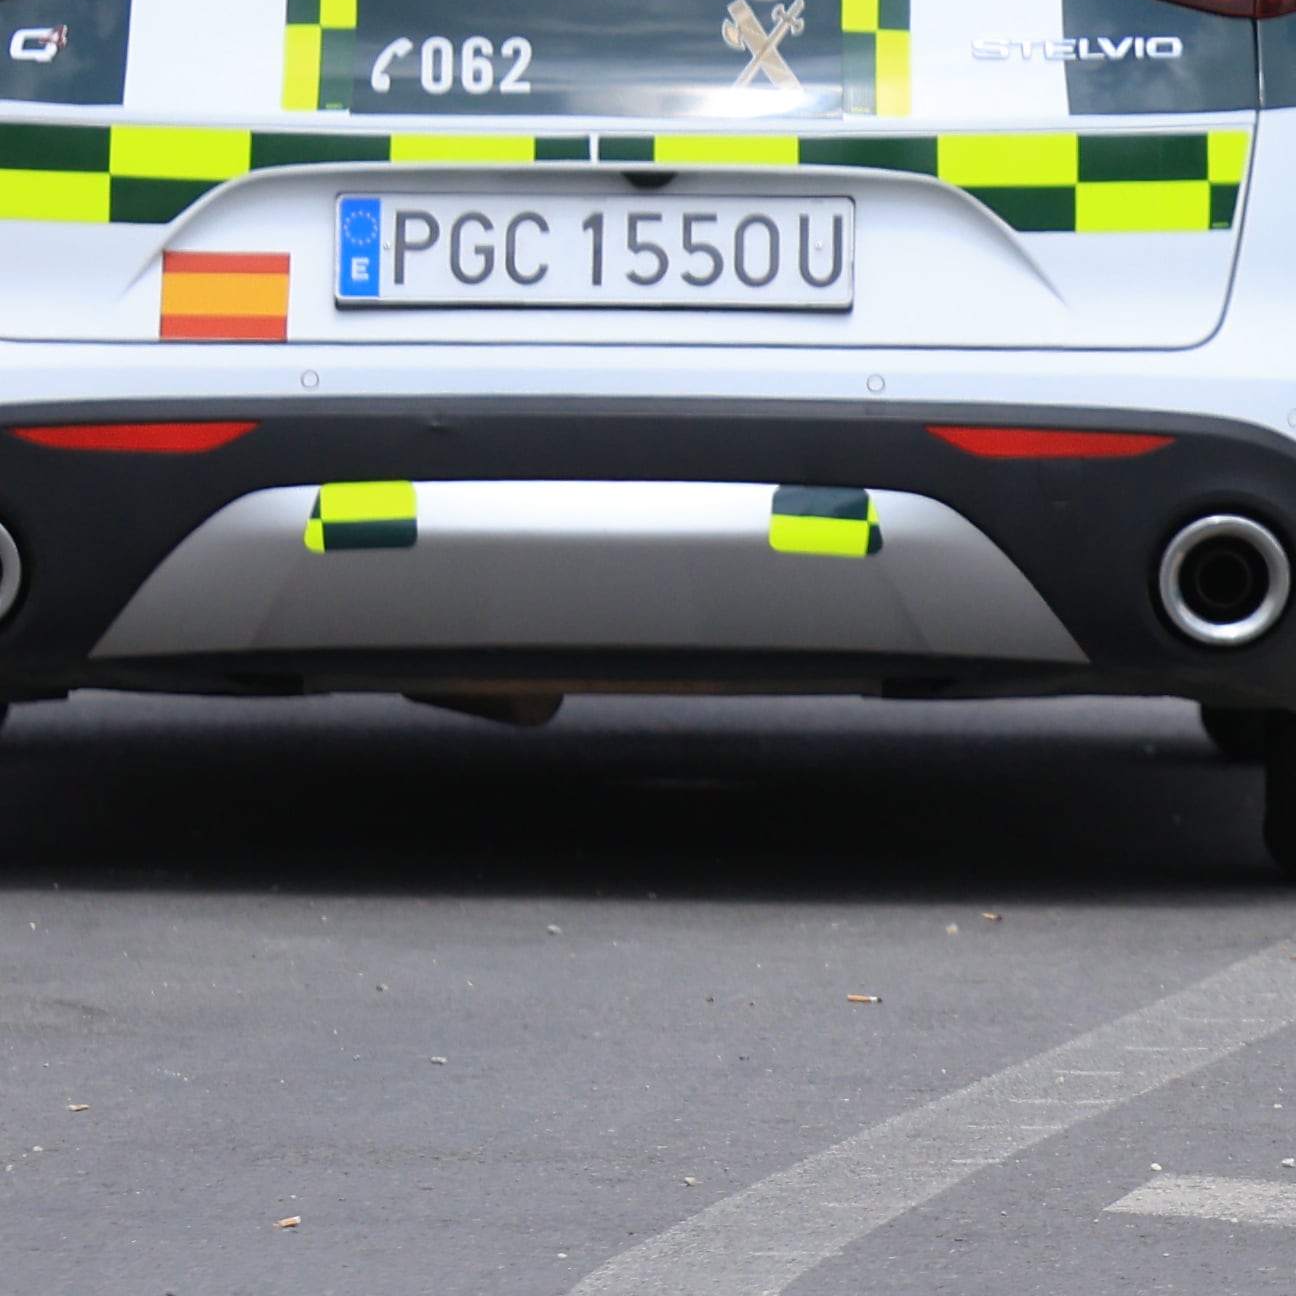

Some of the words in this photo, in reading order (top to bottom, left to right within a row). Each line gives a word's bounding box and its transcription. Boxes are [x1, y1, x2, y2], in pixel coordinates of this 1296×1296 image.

[421, 36, 532, 94] 062
[971, 35, 1183, 61] STELVIO
[393, 210, 549, 286] PGC
[351, 258, 369, 281] E
